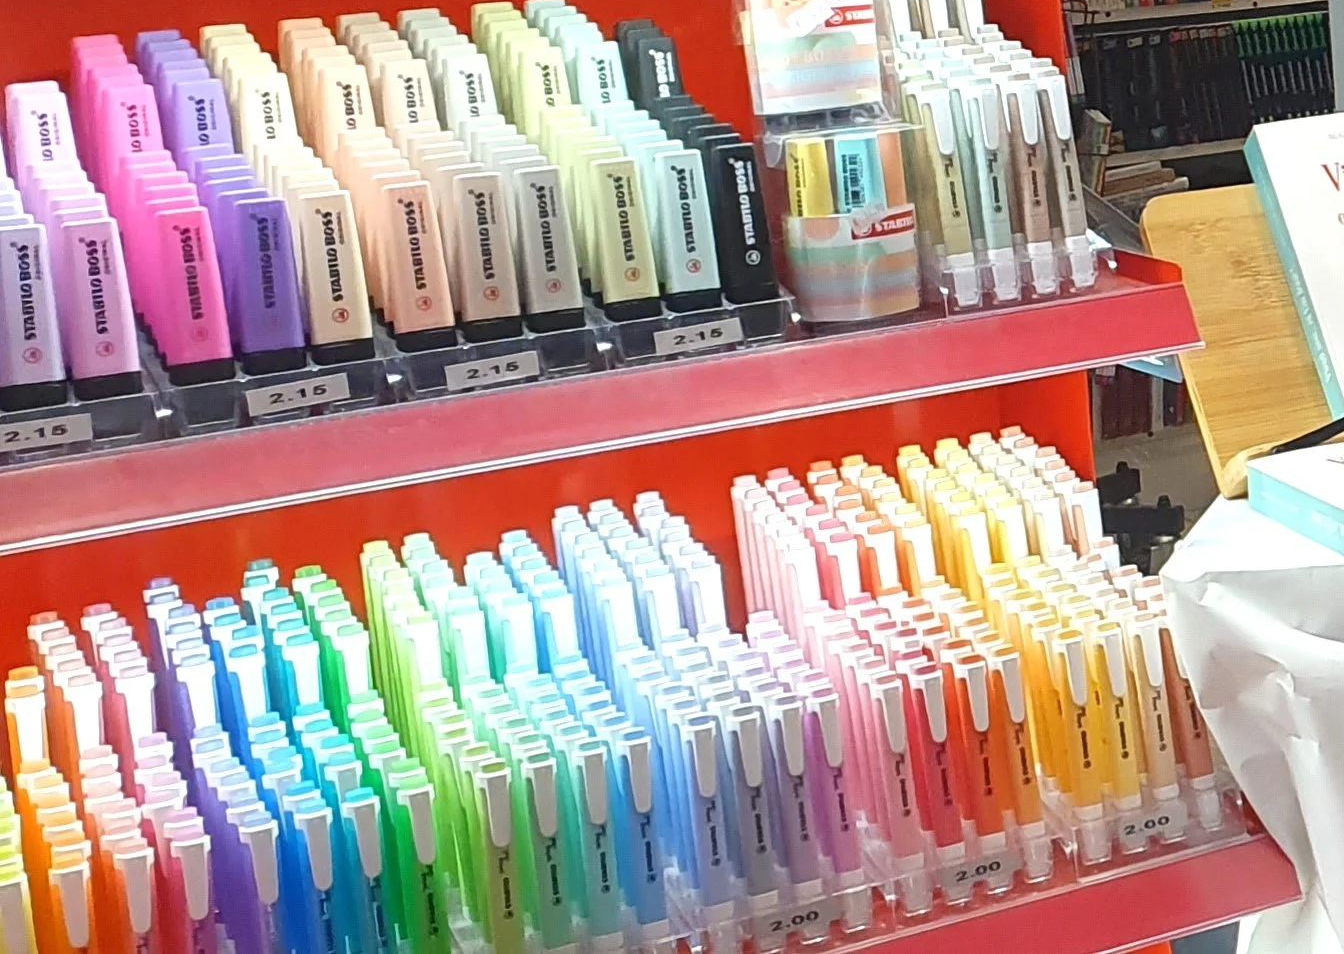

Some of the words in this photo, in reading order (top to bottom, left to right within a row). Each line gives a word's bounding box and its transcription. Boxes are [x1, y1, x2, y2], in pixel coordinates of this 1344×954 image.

[613, 176, 628, 209] BOSS
[677, 168, 690, 201] BOSS
[734, 160, 749, 194] BOSS
[404, 201, 419, 236] BOSS
[475, 192, 490, 227] BOSS
[536, 185, 551, 219] BOSS
[321, 211, 337, 247] BOSS
[619, 211, 635, 262] STABILO
[680, 203, 696, 253] STABILO
[739, 196, 756, 245] STABILO
[17, 244, 32, 283] BOSS
[85, 239, 101, 277] BOSS
[410, 237, 427, 290] STABILO
[480, 228, 495, 280] STABILO
[540, 220, 557, 272] STABILO
[327, 248, 344, 302] STABILO
[20, 284, 37, 341] STABILO
[90, 278, 108, 335] STABILO
[673, 328, 724, 346] 2.15
[466, 361, 520, 380] 2.15
[269, 384, 328, 404] 2.15
[4, 423, 69, 443] 2.15
[1124, 815, 1171, 836] 2.00
[955, 860, 1002, 882] 2.00
[771, 910, 819, 932] 2.00
